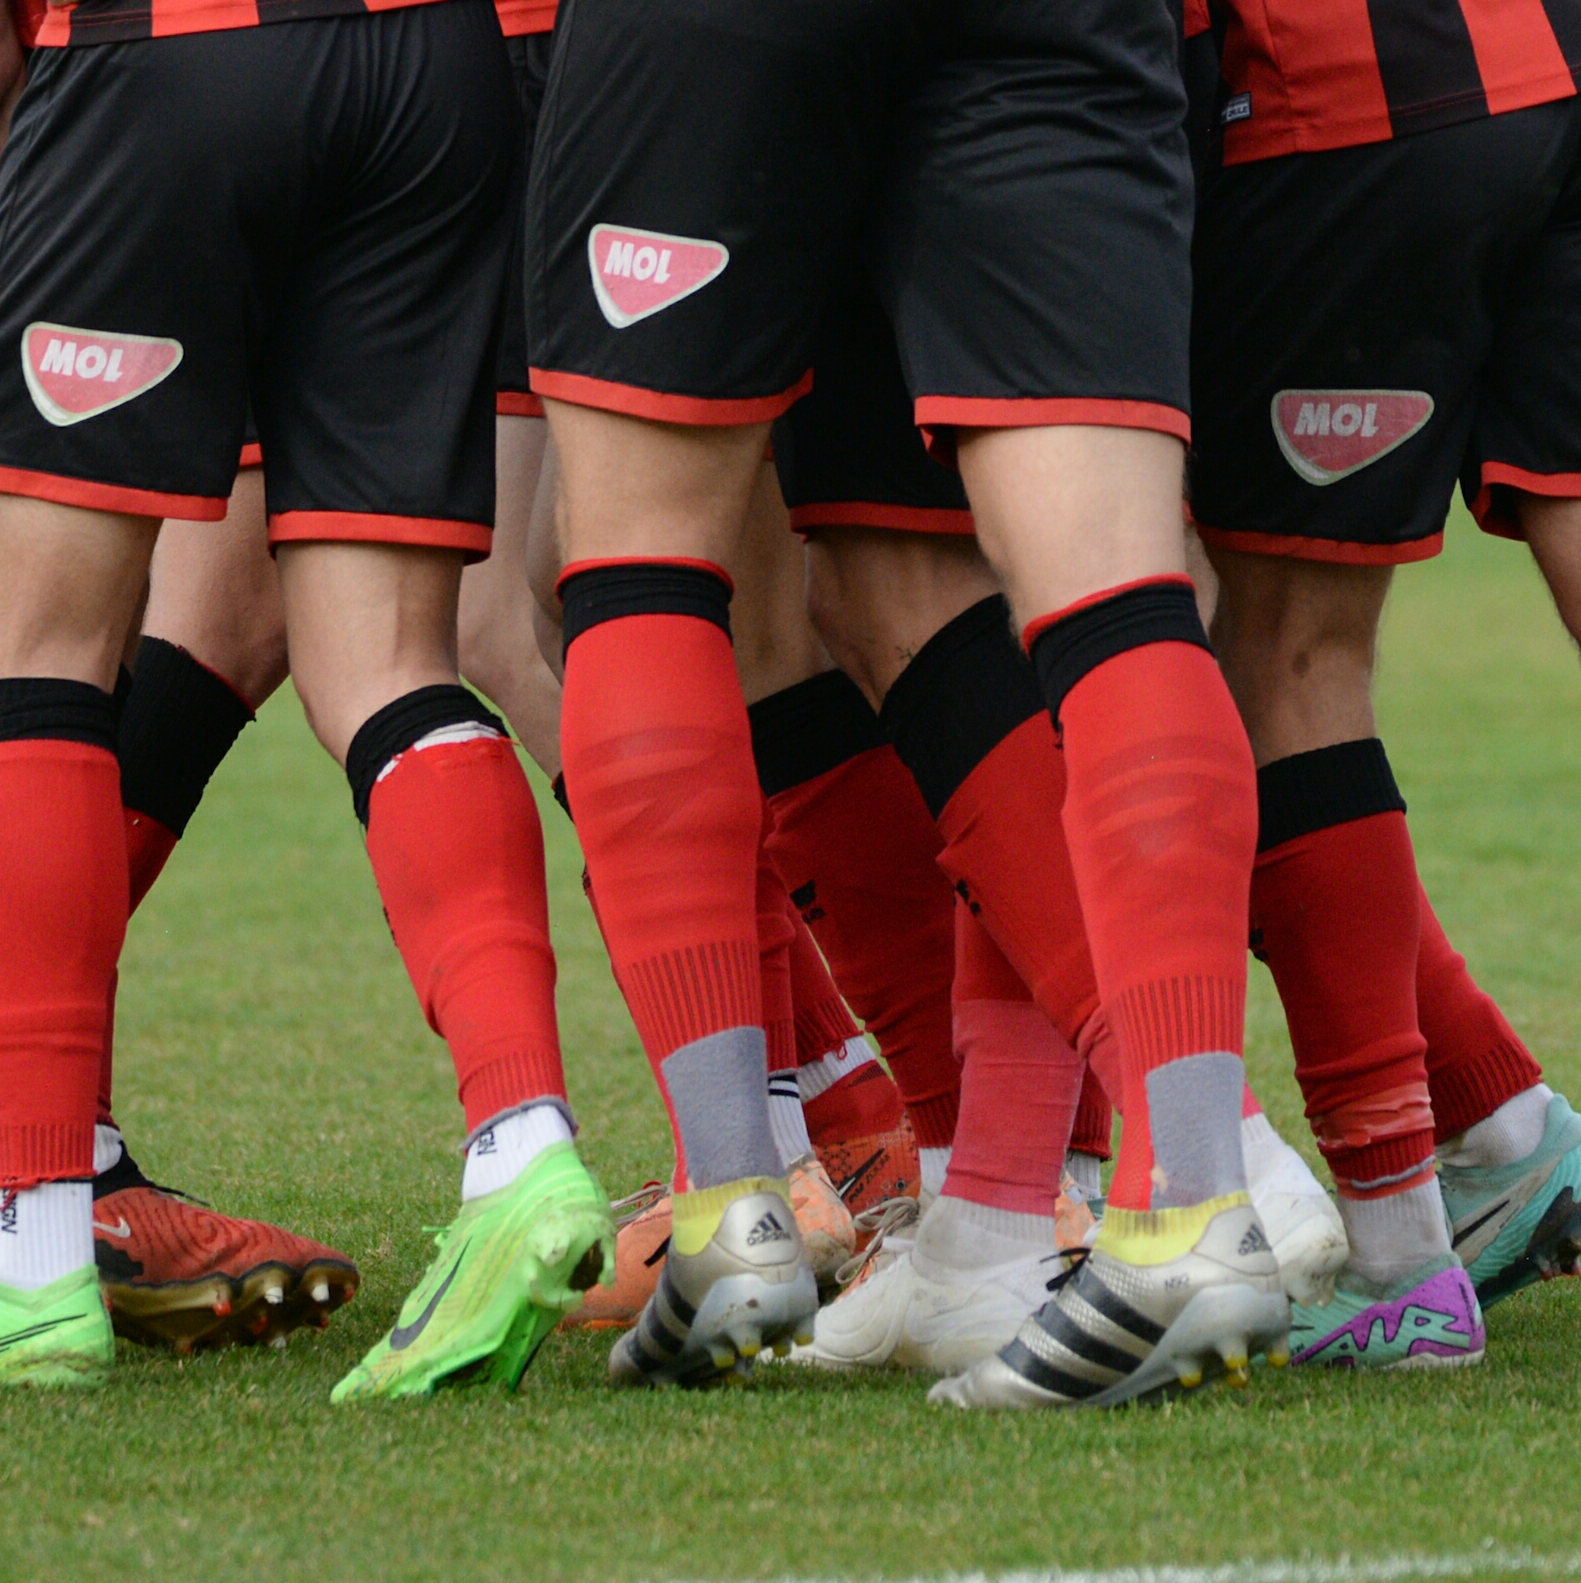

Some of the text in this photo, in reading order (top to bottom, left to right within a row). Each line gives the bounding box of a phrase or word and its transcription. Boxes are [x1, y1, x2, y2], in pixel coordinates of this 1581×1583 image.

[604, 240, 672, 285] MOL
[40, 338, 123, 383] MOL
[1293, 402, 1379, 438] MOL
